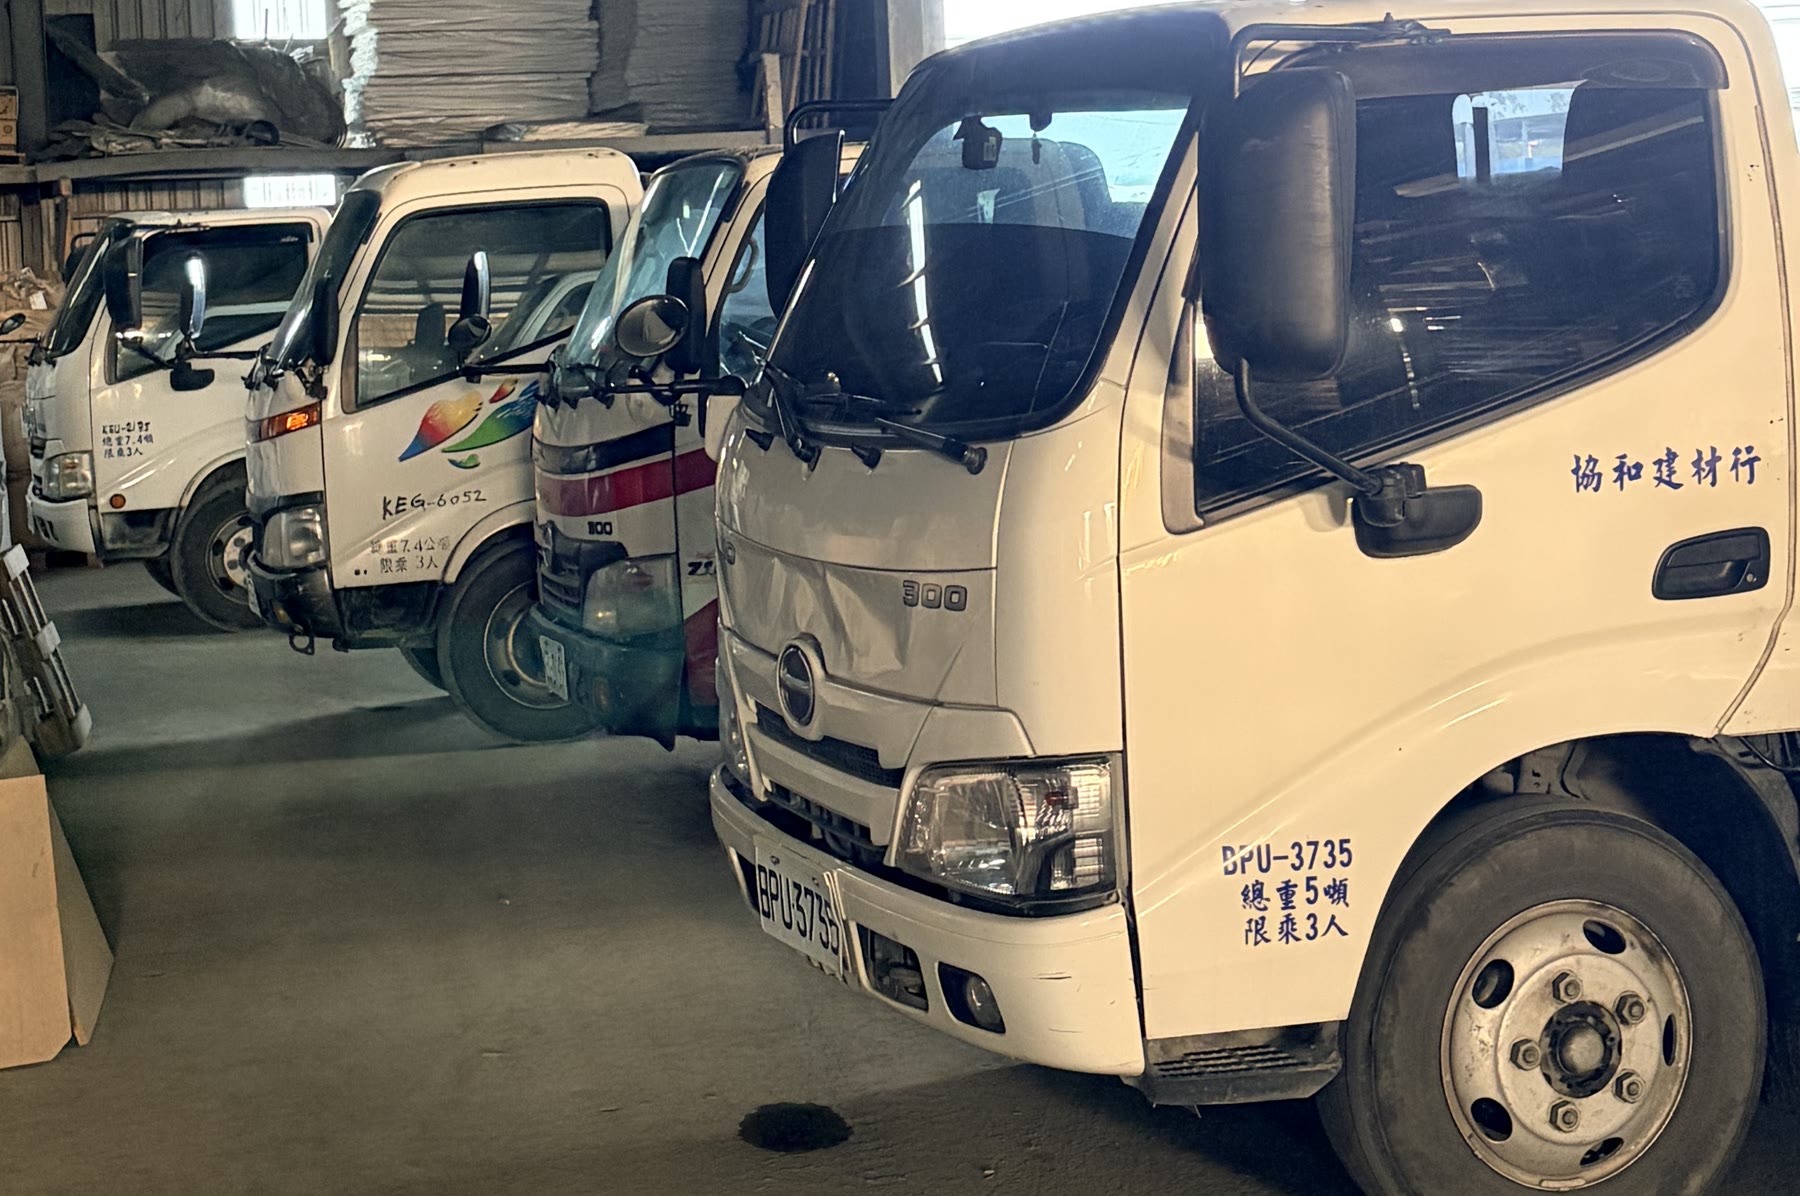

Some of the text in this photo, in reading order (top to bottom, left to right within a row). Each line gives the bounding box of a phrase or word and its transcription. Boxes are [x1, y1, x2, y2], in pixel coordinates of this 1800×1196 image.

[1571, 445, 1762, 493] 協和建材行
[382, 490, 487, 521] KEG-6052
[903, 580, 968, 612] 300
[1222, 838, 1353, 876] BPU-3735
[1240, 876, 1350, 912] 總重5噸
[1245, 912, 1350, 947] 限乘3人
